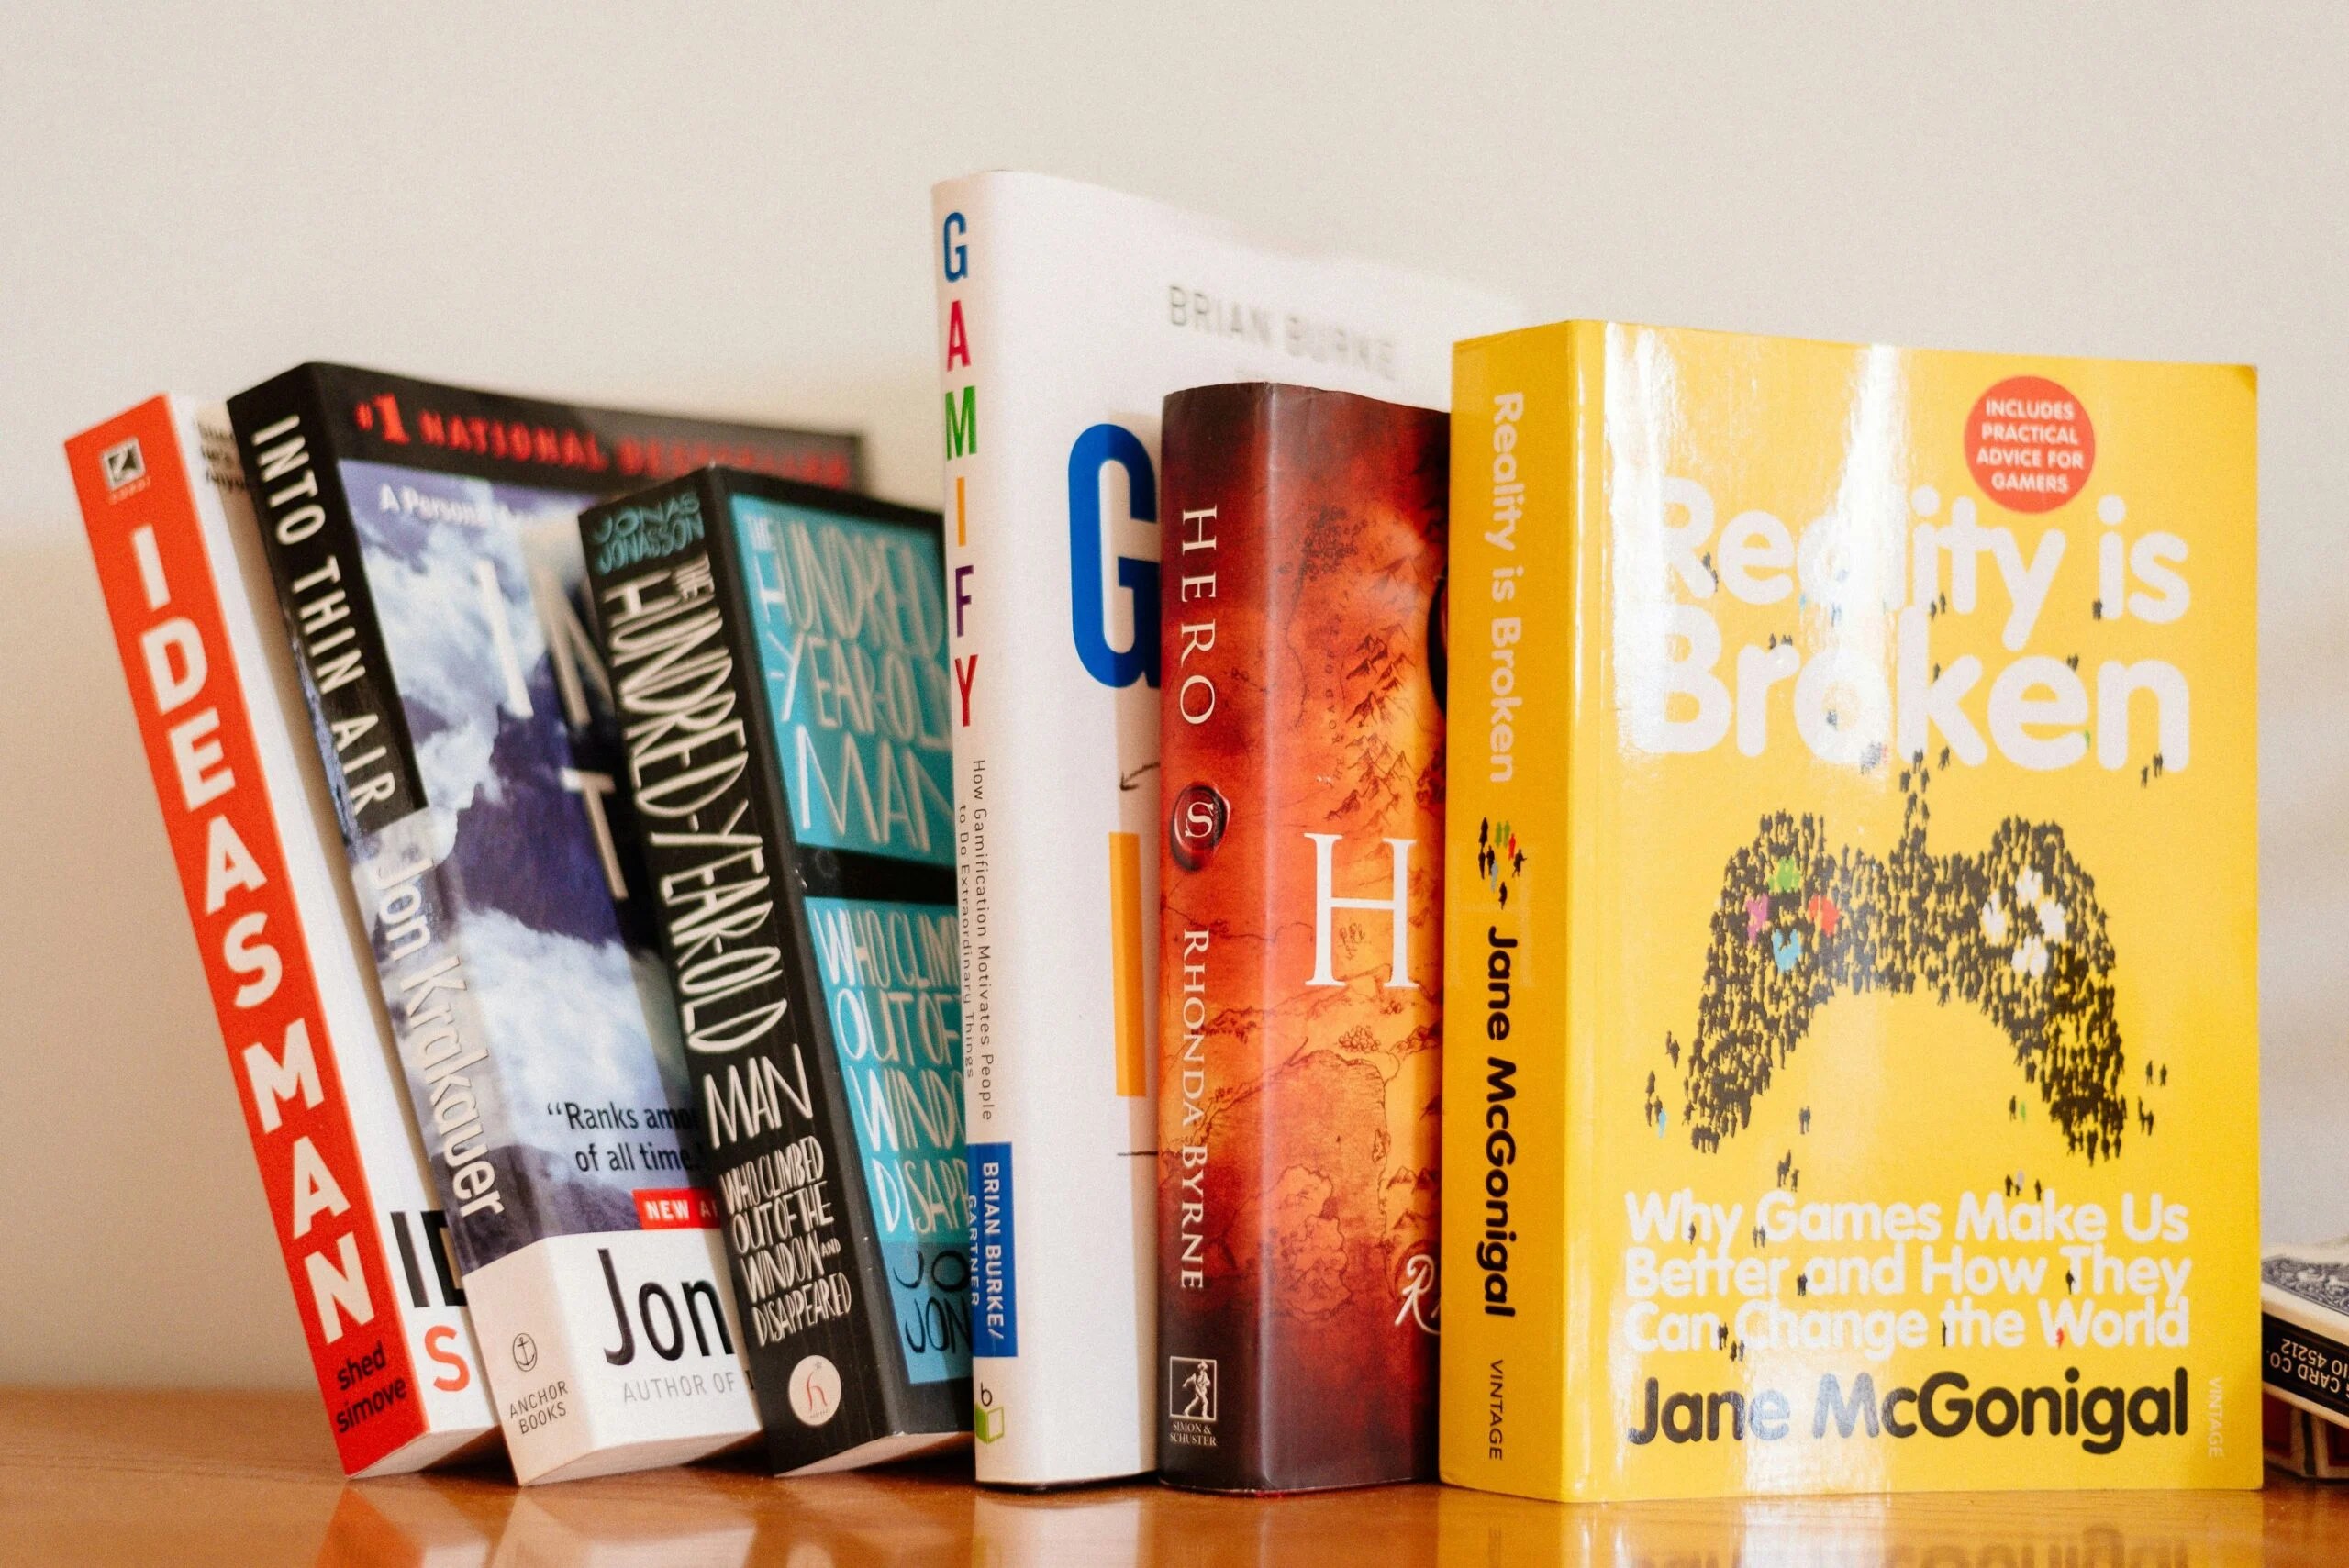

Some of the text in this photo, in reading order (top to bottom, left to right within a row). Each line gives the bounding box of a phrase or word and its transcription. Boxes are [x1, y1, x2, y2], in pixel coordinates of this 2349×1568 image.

[1168, 284, 1273, 348] BRIAN
[418, 408, 609, 472] NATIONAL
[1981, 422, 2078, 446] PRACTICAL
[1985, 397, 2076, 421] INCLUDES
[942, 211, 980, 728] GAMIFY
[1976, 447, 2085, 470] ADVICE FOR
[1991, 471, 2069, 495] GAMERS
[591, 489, 701, 544] JONAS
[595, 512, 706, 575] JONASSON
[1483, 391, 1525, 783] Reality is Broken
[1638, 474, 2191, 652] Reality is
[250, 415, 396, 817] INTO THIN AIR
[1179, 505, 1218, 726] HERO
[1631, 602, 2191, 773] Broken
[672, 552, 715, 600] THE
[703, 1042, 814, 1150] MAN
[959, 804, 975, 1080] to Do Extraordinary Things
[972, 759, 995, 1122] How Gamification Motivates People
[1303, 831, 1420, 990] H
[812, 907, 892, 990] WHO
[369, 857, 506, 1218] Jon Krakauer
[835, 987, 961, 1068] OUT OF
[1180, 928, 1210, 1290] RHONDA BYRNE
[1475, 925, 1520, 1319] Jane McGonigal
[574, 1141, 603, 1173] of
[607, 1142, 636, 1172] all
[719, 1135, 825, 1216] WHO CLIMBED
[644, 1199, 690, 1221] NEW
[732, 1180, 835, 1255] OUT OF THE
[1623, 1188, 2189, 1258] Why Games Make Us
[740, 1229, 841, 1304] WINDOW AND
[967, 1194, 981, 1308] GARTNER
[982, 1162, 1006, 1341] BRIAN BURKE/
[1623, 1244, 2191, 1310] Better and How They
[751, 1271, 852, 1348] DISAPPEARED
[1622, 1294, 2189, 1362] Can Change the World
[336, 1339, 387, 1391] shed
[622, 1373, 707, 1404] AUTHOR
[712, 1371, 736, 1394] OF
[2279, 1336, 2328, 1369] 45212
[2298, 1362, 2341, 1394] CARD
[335, 1377, 408, 1434] simove
[509, 1380, 569, 1419] ANCHOR
[519, 1401, 567, 1435] BOOKS
[1173, 1420, 1212, 1435] SIMON &
[1488, 1357, 1505, 1462] VINTAGE
[1626, 1365, 2188, 1456] Jane McGonigal
[2207, 1375, 2225, 1459] VINTAGE
[1169, 1431, 1218, 1447] SCHUSTER
